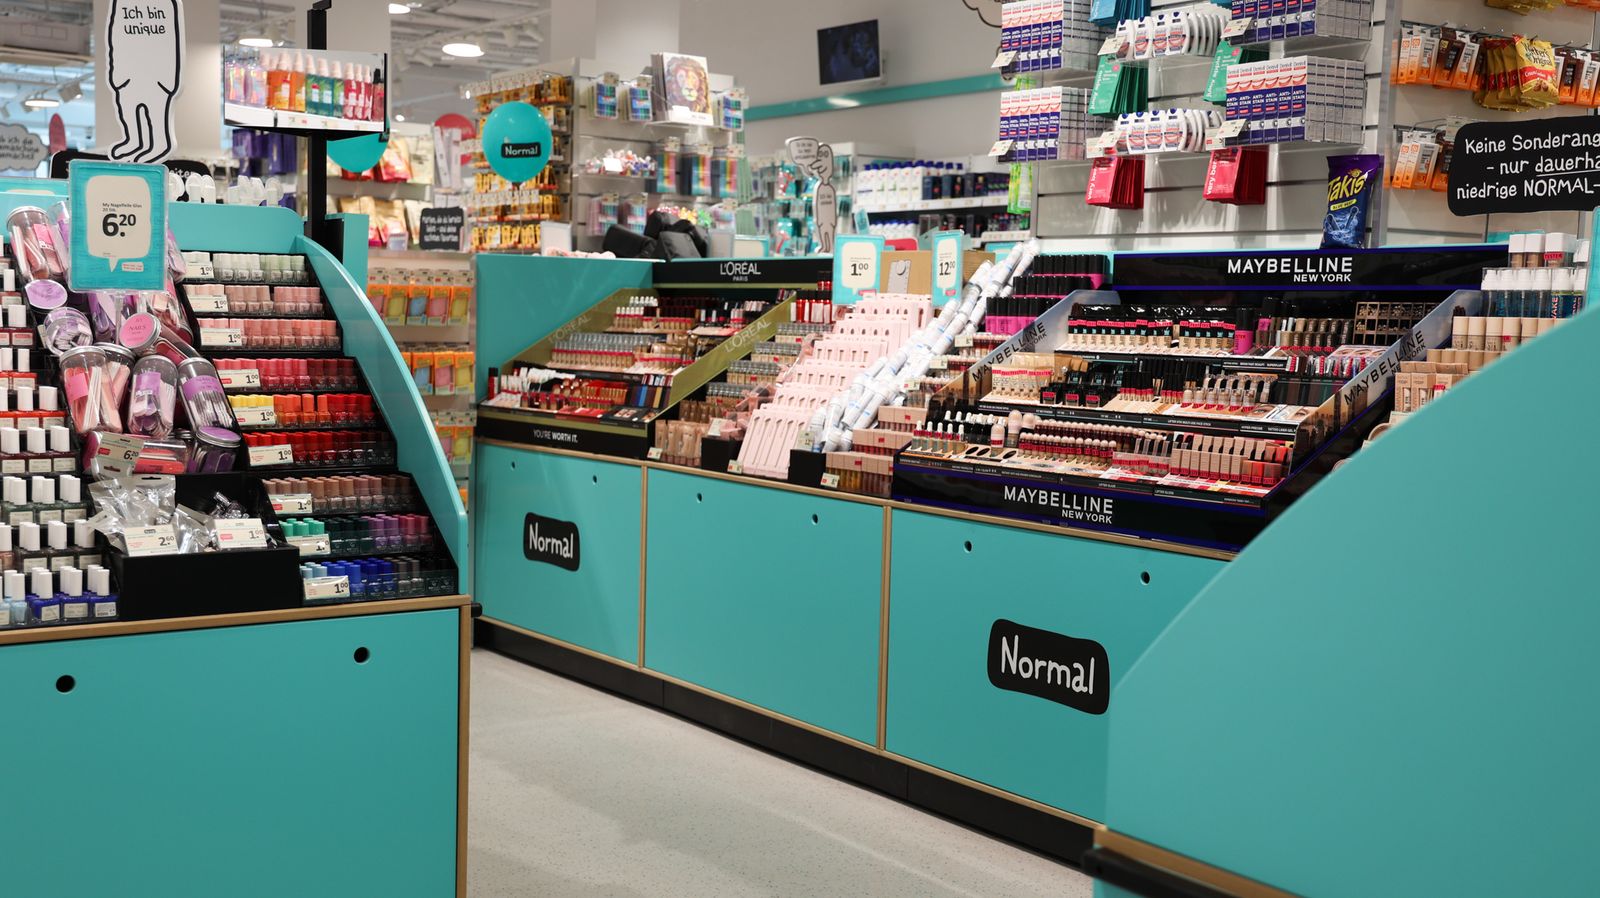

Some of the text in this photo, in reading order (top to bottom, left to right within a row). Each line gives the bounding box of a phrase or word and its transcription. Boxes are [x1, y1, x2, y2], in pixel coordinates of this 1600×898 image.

[122, 6, 166, 19] Ich bin
[124, 22, 166, 36] unique
[505, 145, 538, 156] Normal
[1465, 138, 1506, 154] Keine
[1500, 160, 1529, 175] nur
[1457, 182, 1517, 199] niedrige
[102, 213, 136, 237] 6.20
[720, 261, 761, 276] L'ORÉAL
[851, 263, 868, 276] 1.00
[1228, 257, 1352, 273] MAYBELLINE
[1294, 274, 1351, 282] NEW YORK
[972, 322, 1046, 381] MAYBELLINE
[1344, 331, 1424, 405] MAYBELLINE
[552, 432, 571, 442] WORTH
[123, 450, 139, 461] 6.20
[1004, 485, 1113, 514] MAYBELLINE
[1062, 509, 1112, 524] NEW YORK
[158, 536, 174, 546] 2.60
[530, 522, 573, 559] Normal
[1001, 635, 1094, 694] Normal
